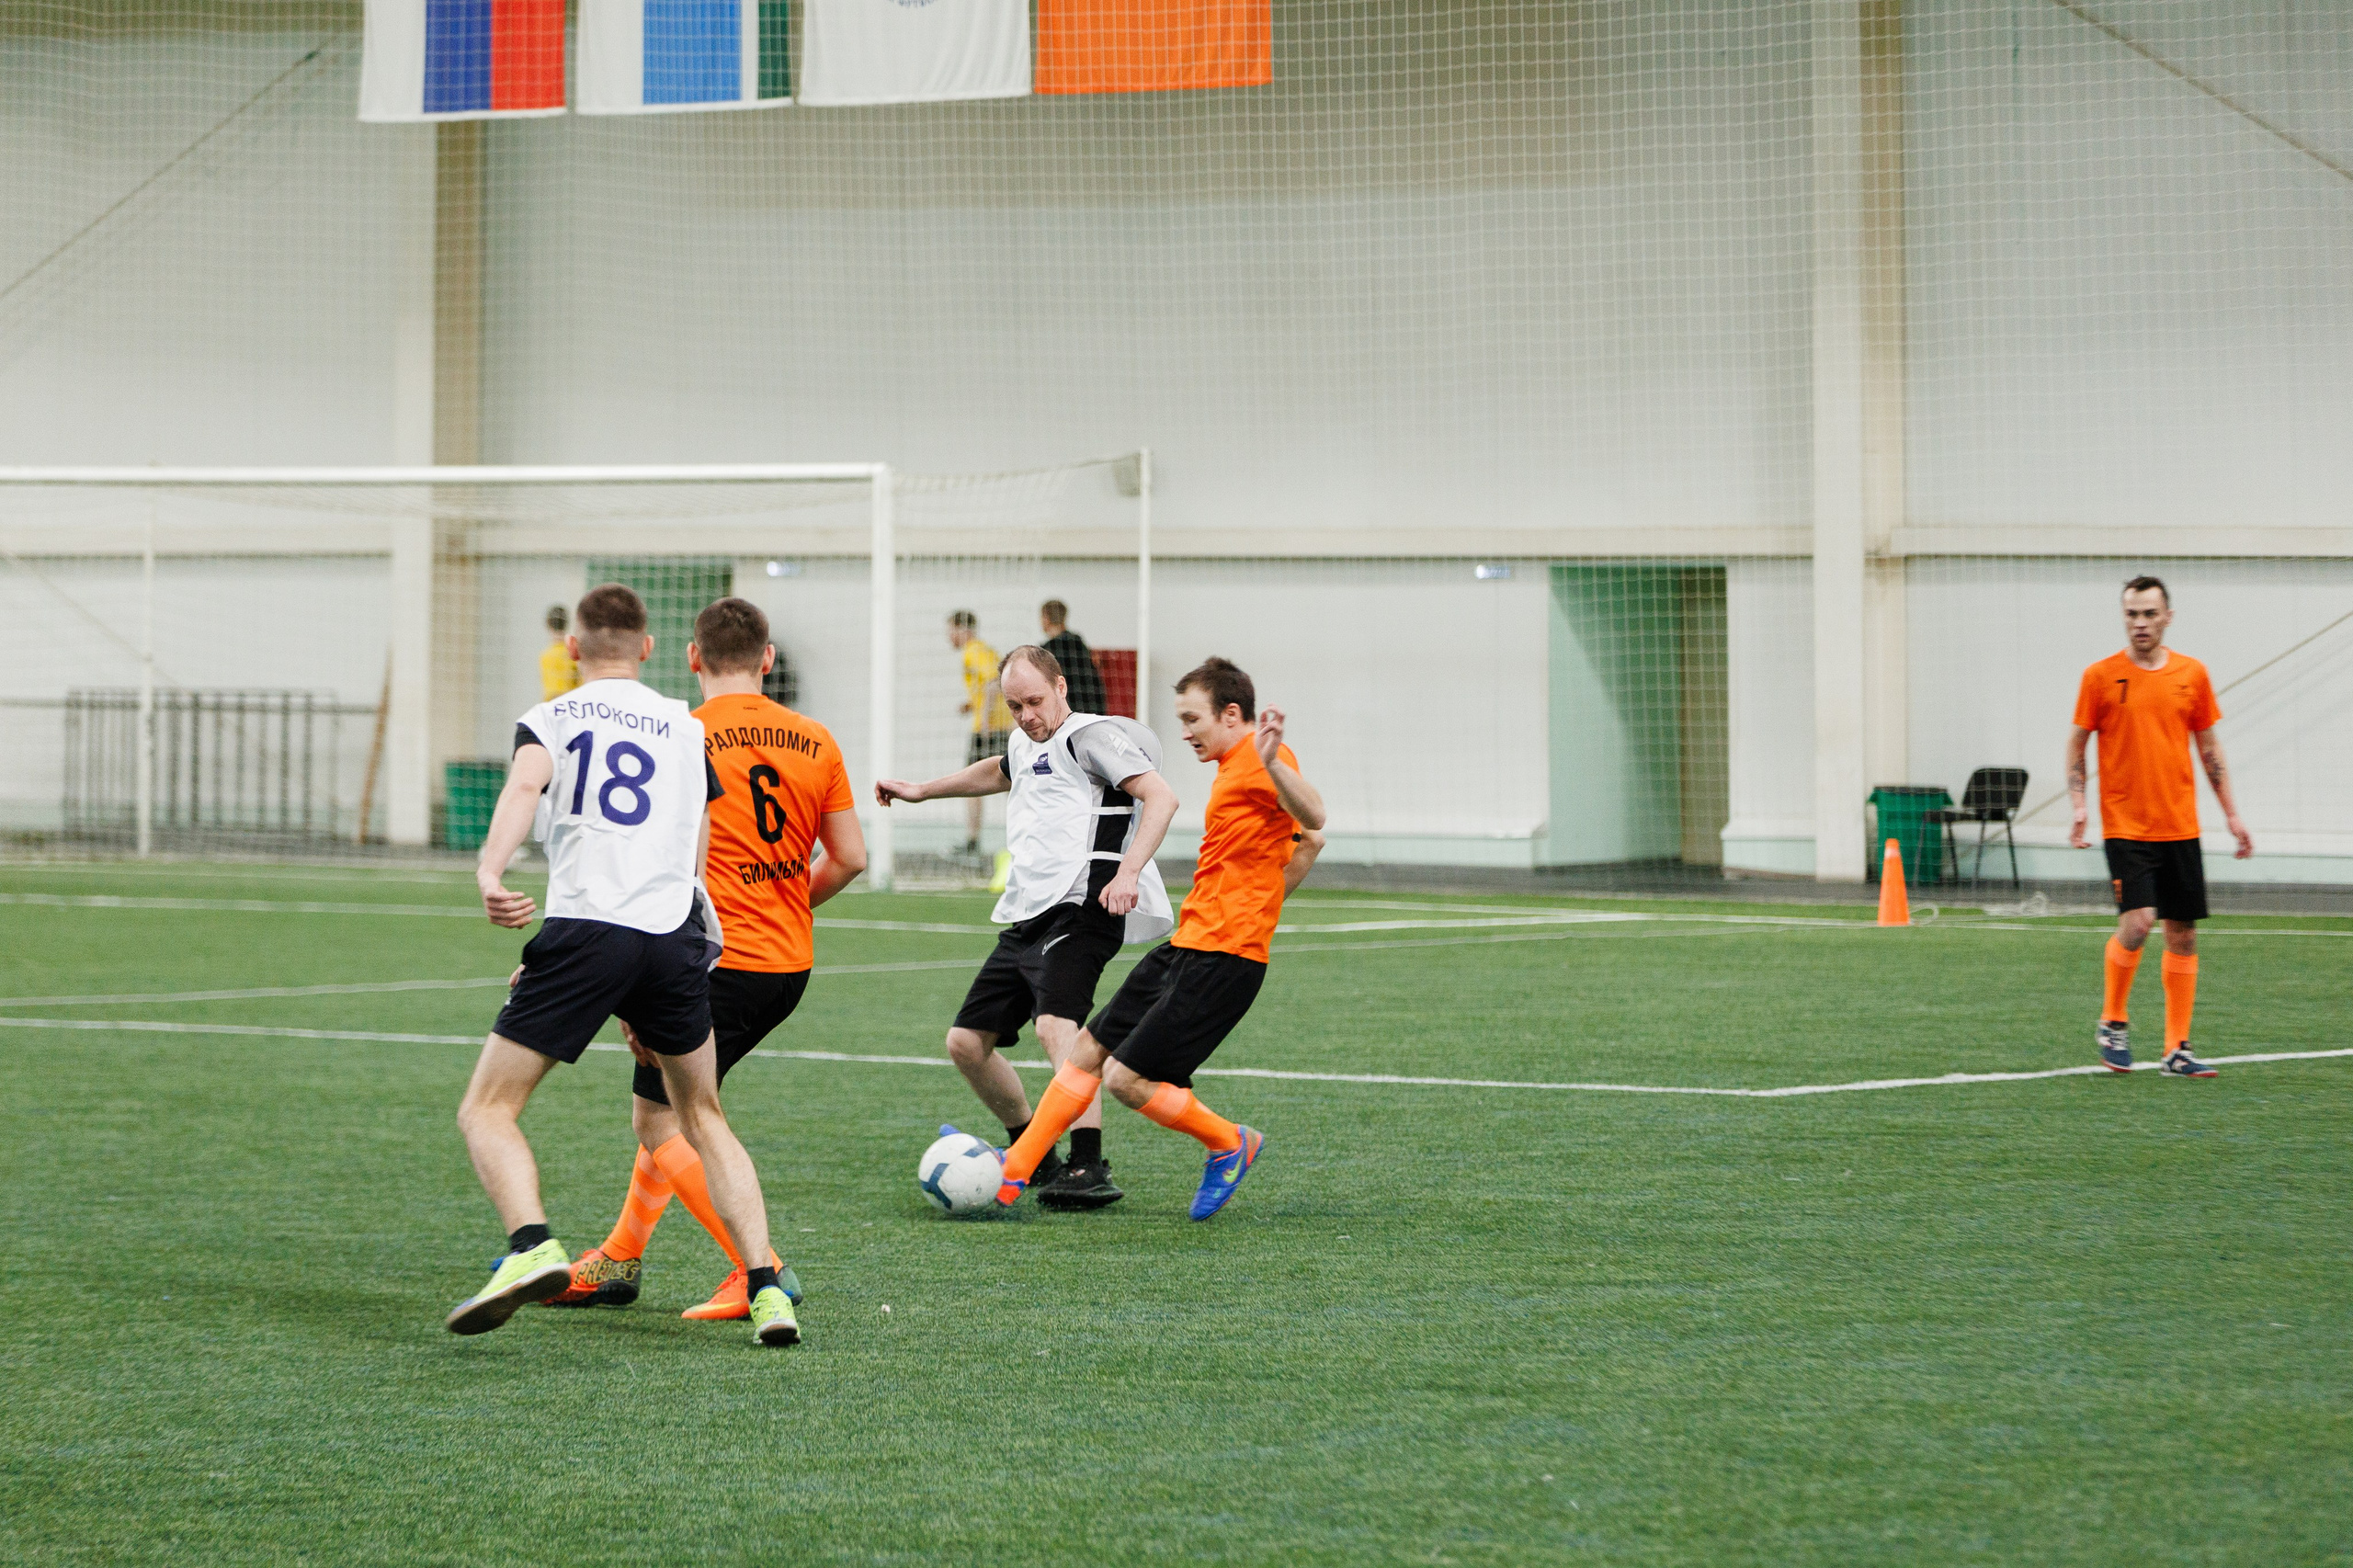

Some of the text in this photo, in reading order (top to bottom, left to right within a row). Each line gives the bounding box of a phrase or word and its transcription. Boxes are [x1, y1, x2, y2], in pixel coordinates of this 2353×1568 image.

[2116, 678, 2129, 705] 7
[565, 730, 655, 826] 18
[748, 764, 788, 844] 6
